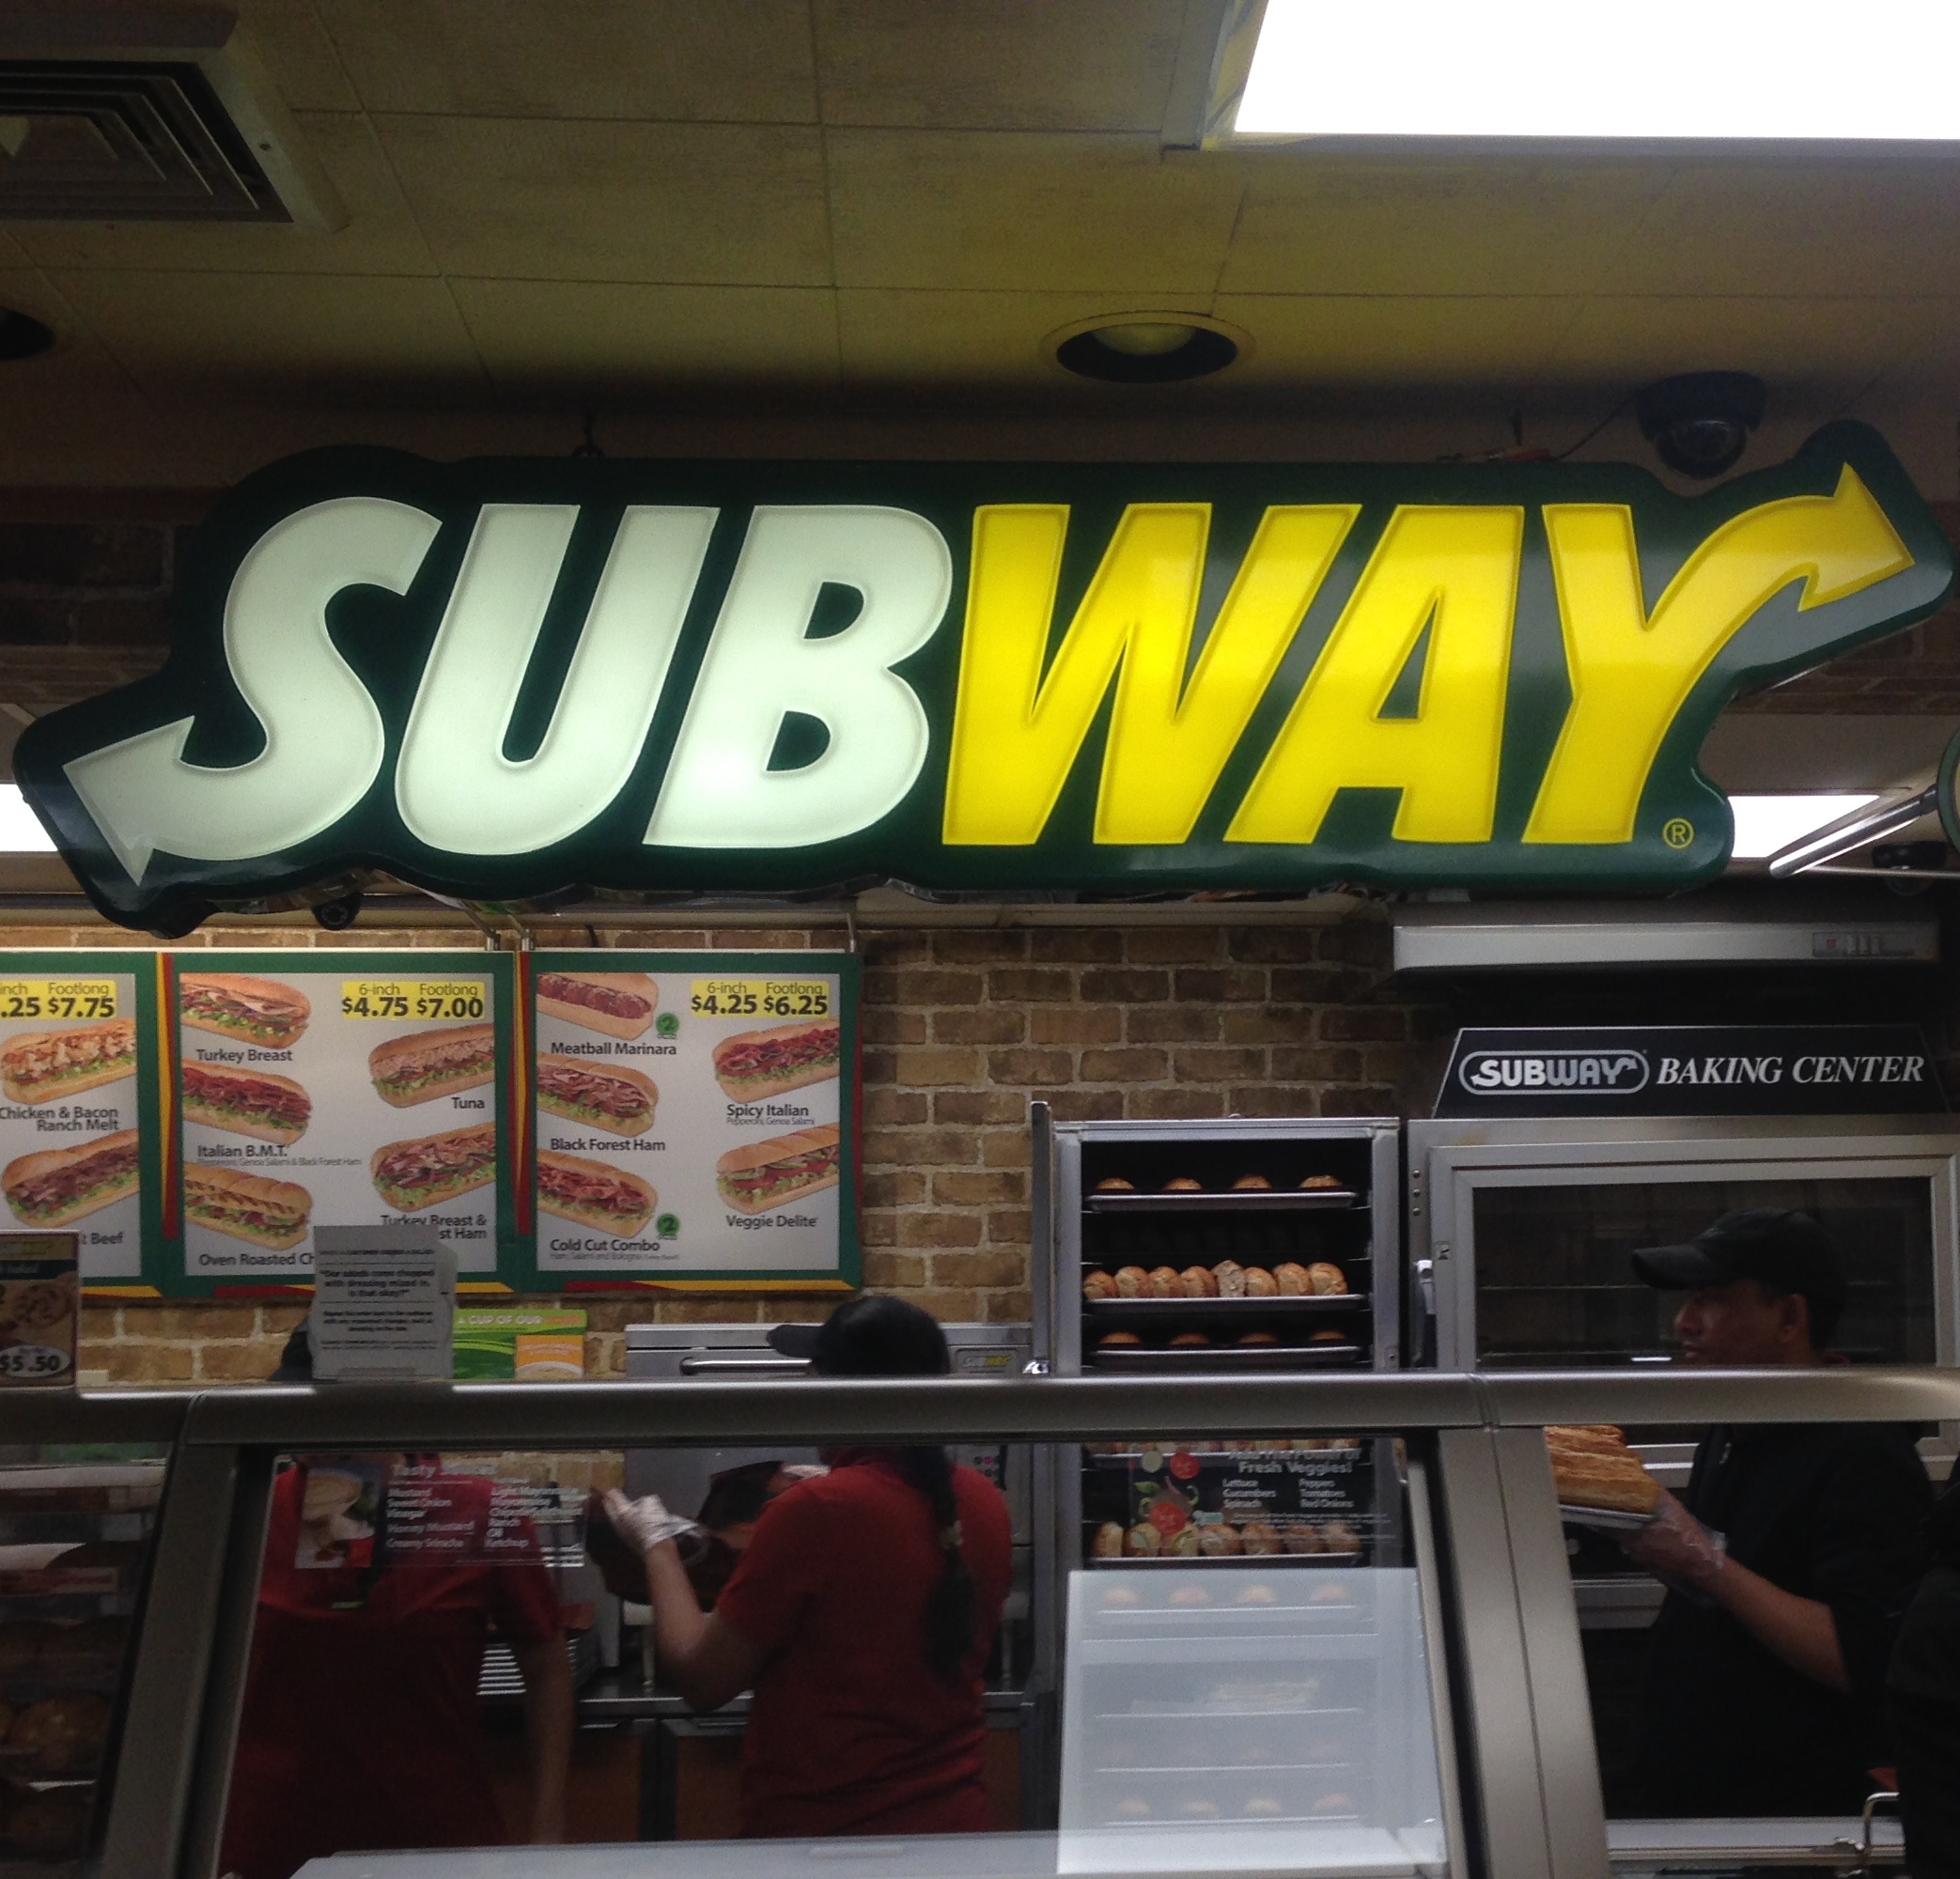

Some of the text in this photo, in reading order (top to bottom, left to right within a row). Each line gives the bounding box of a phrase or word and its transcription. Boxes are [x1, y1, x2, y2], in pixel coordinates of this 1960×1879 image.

[62, 462, 1915, 888] SUBWAY
[48, 982, 109, 997] Footlong
[359, 982, 478, 998] 6-inch Footlong
[707, 982, 823, 996] 6-inch Footlong
[49, 997, 115, 1018] $7.75
[342, 998, 483, 1018] $4.75 $7.00
[692, 995, 828, 1016] $4.25 $6.25
[551, 1042, 677, 1055] Meatball Marinara
[196, 1049, 292, 1064] Turkey Breast
[1470, 1053, 1924, 1088] SUBWAY BAKING CENTER
[452, 1096, 486, 1110] Tuna
[0, 1106, 55, 1120] Chicken
[73, 1107, 118, 1119] Bacon
[727, 1104, 809, 1119] Spicy Italian
[37, 1120, 118, 1131] Ranch Melt
[198, 1145, 241, 1157] Italian
[551, 1139, 666, 1151] Black Forest Ham
[429, 1214, 473, 1226] Breast
[475, 1214, 487, 1226] &
[727, 1215, 817, 1229] Veggie Delite
[91, 1233, 124, 1245] Beef
[455, 1228, 487, 1240] Ham
[551, 1238, 661, 1251] Cold Cut Combo
[199, 1253, 236, 1266] Oven
[240, 1253, 296, 1266] Roasted
